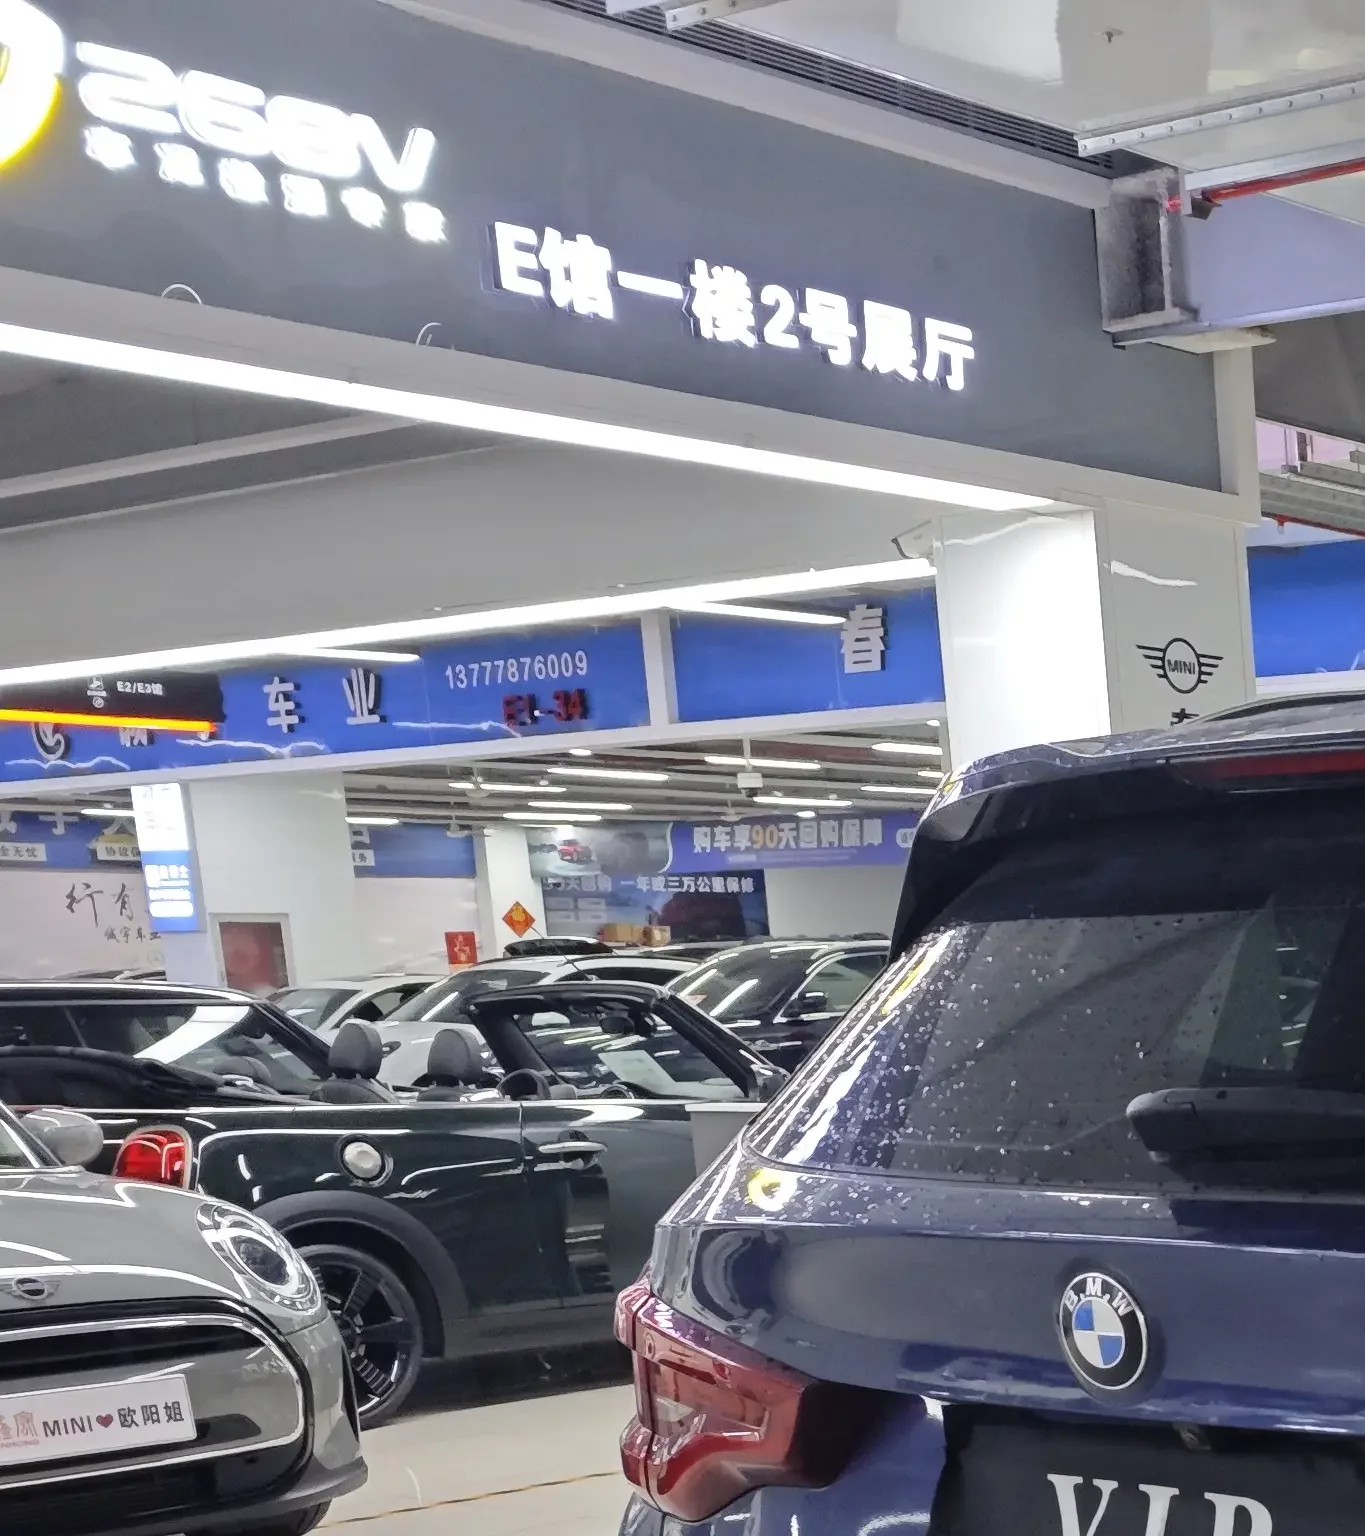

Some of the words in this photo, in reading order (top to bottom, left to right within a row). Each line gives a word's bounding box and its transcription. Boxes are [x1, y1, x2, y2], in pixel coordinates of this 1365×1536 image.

[494, 220, 976, 393] E馆一楼2号展厅
[841, 603, 885, 673] 春
[445, 650, 588, 689] 13777876009
[1167, 659, 1196, 675] MINI
[1064, 1277, 1135, 1317] BMW
[42, 1415, 93, 1438] MINI
[117, 1401, 184, 1429] 欧阳姐
